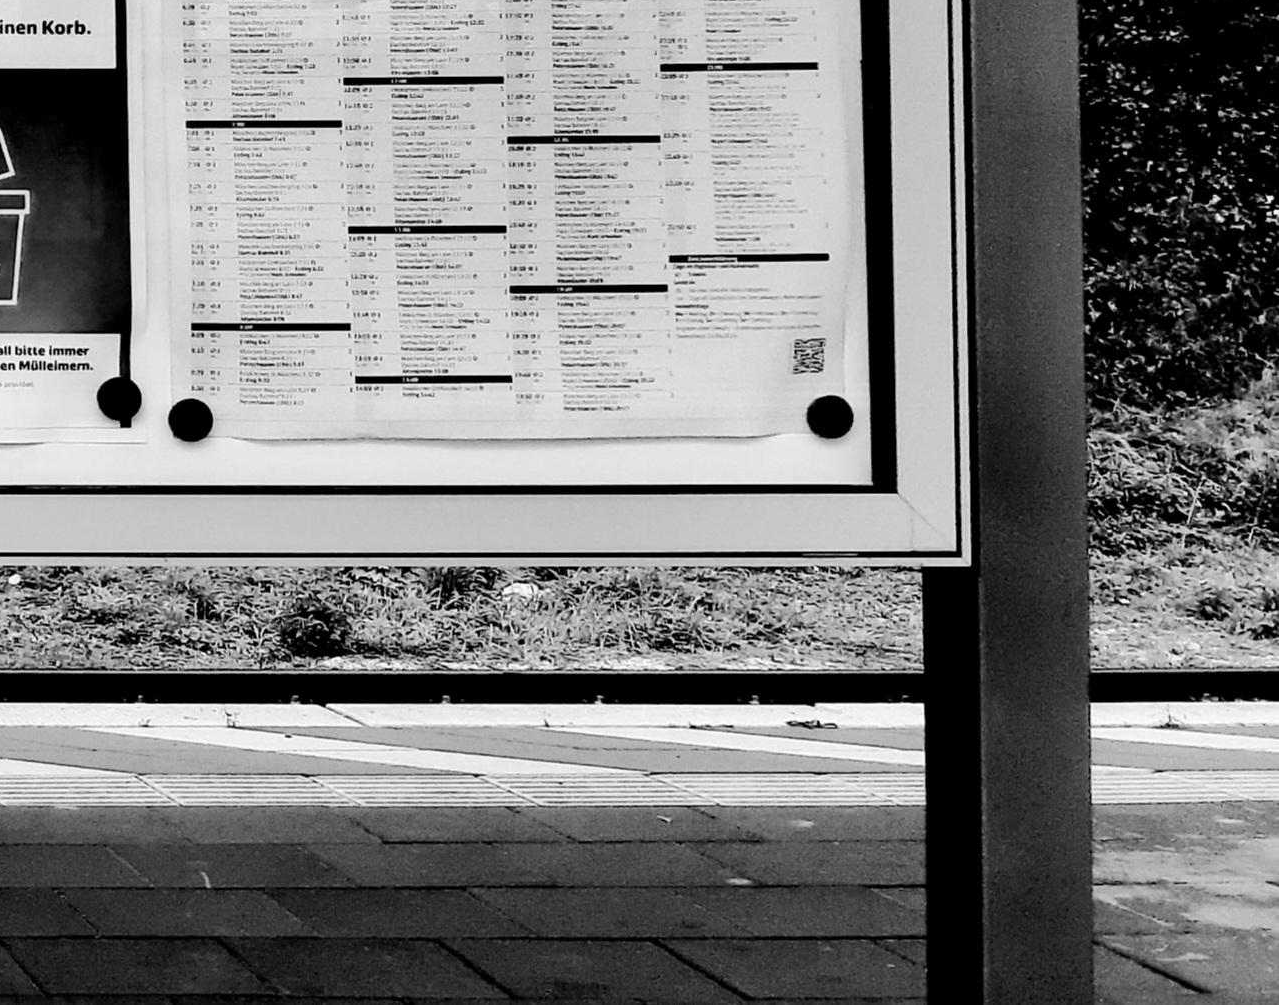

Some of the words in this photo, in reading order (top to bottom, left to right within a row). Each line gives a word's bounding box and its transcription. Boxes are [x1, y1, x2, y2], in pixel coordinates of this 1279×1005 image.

[42, 20, 91, 35] Korb.
[14, 345, 46, 357] bitte
[48, 346, 90, 357] immer
[18, 359, 94, 372] Mülleimern.
